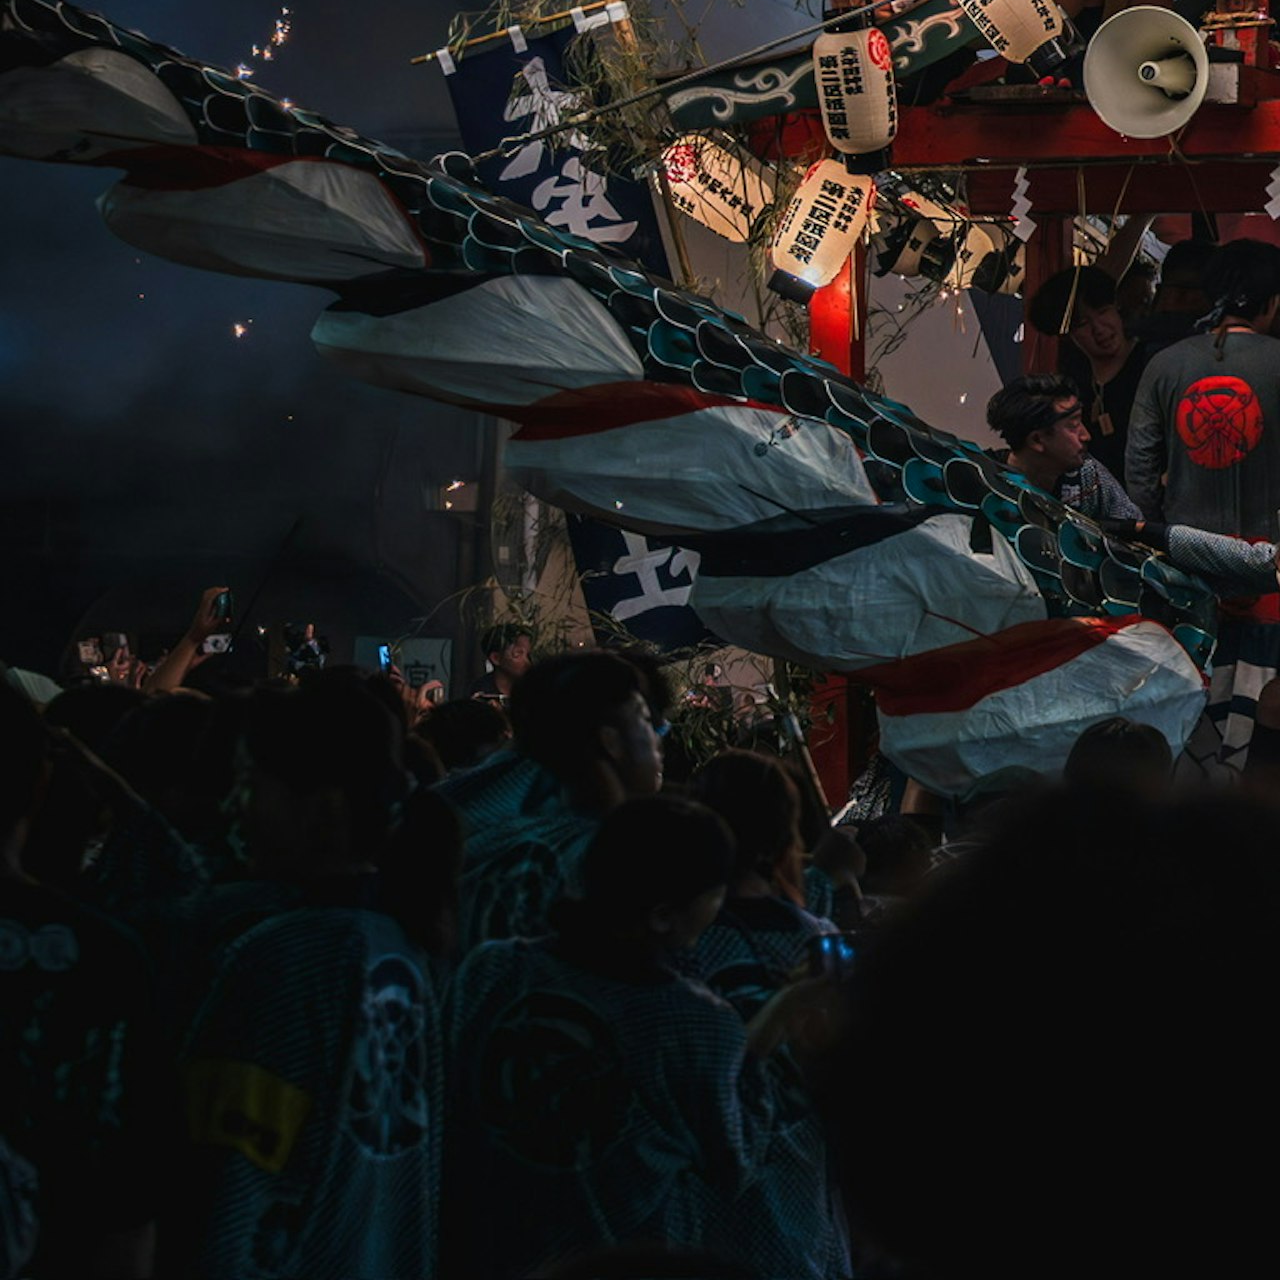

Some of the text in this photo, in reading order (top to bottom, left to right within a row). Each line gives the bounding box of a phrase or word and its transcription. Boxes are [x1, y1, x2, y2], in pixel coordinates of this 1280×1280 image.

[787, 179, 847, 265] 第二区祇園祭
[833, 185, 866, 234] 大牟田神社
